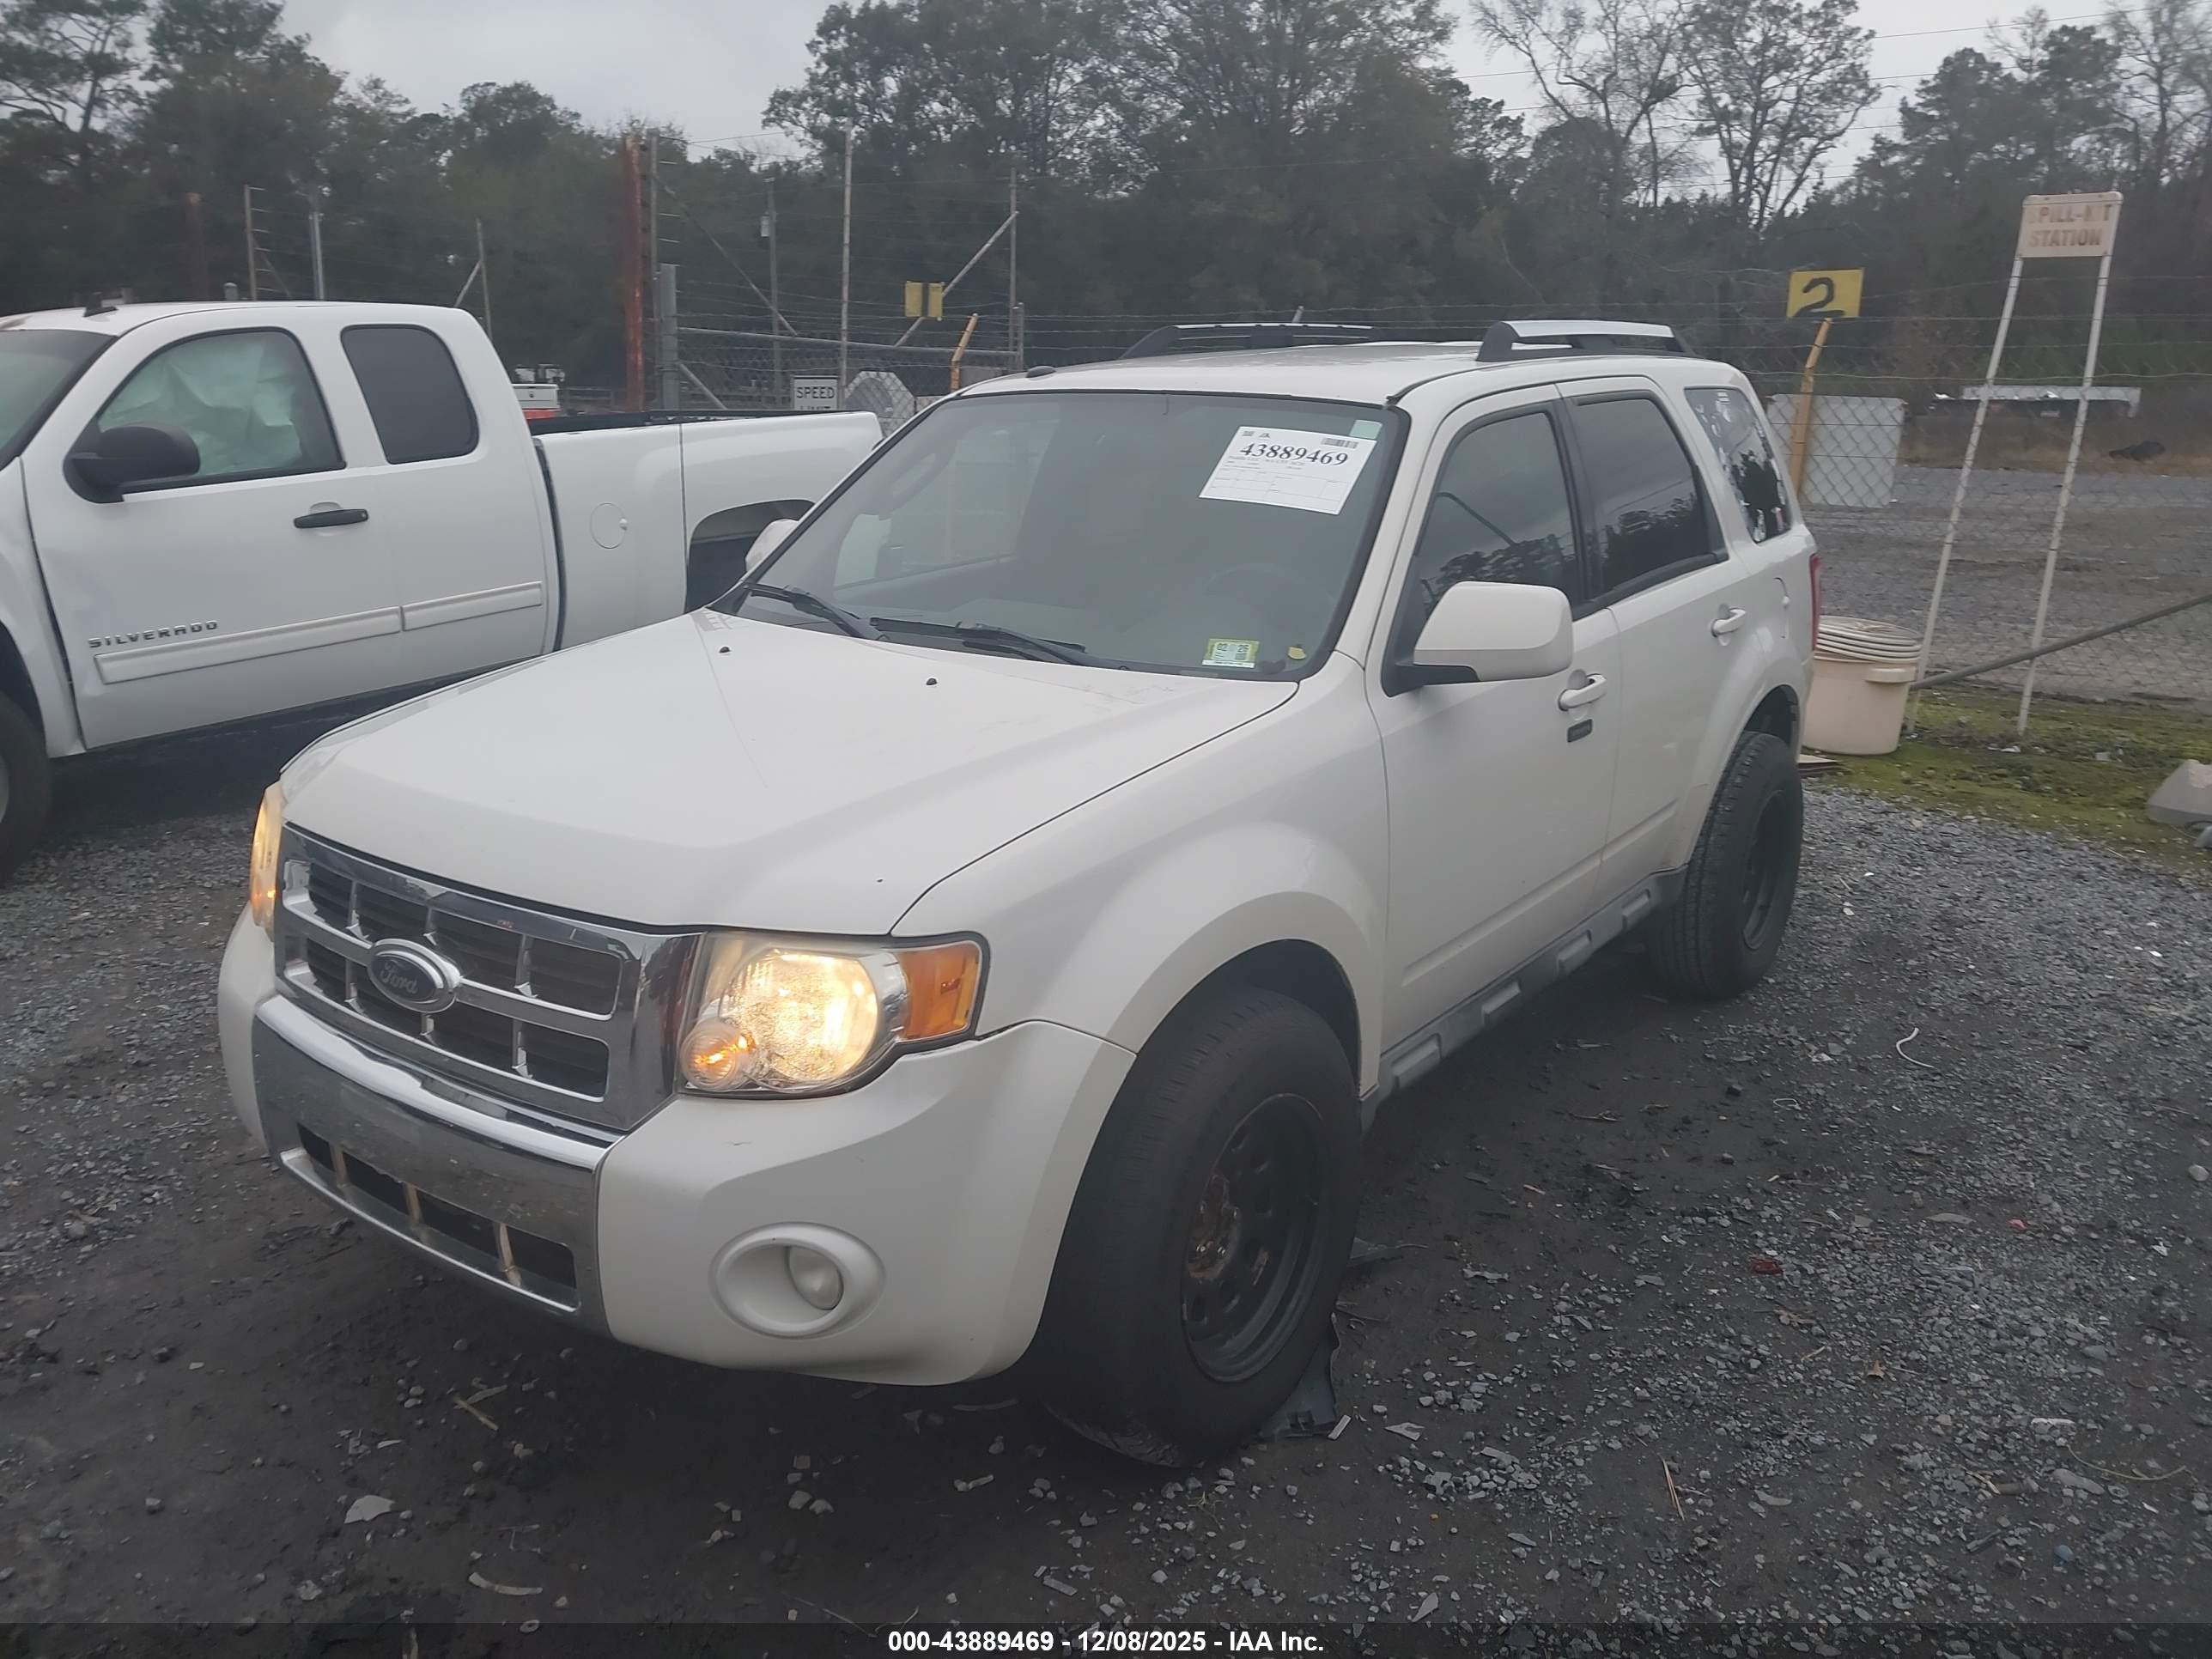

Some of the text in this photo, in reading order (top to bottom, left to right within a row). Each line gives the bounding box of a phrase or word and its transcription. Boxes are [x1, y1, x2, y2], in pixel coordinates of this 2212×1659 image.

[1794, 276, 1845, 318] 2
[796, 386, 835, 399] SPEED
[1240, 442, 1348, 465] 43889469
[88, 620, 217, 647] SILVERADO
[380, 962, 418, 994] Ford
